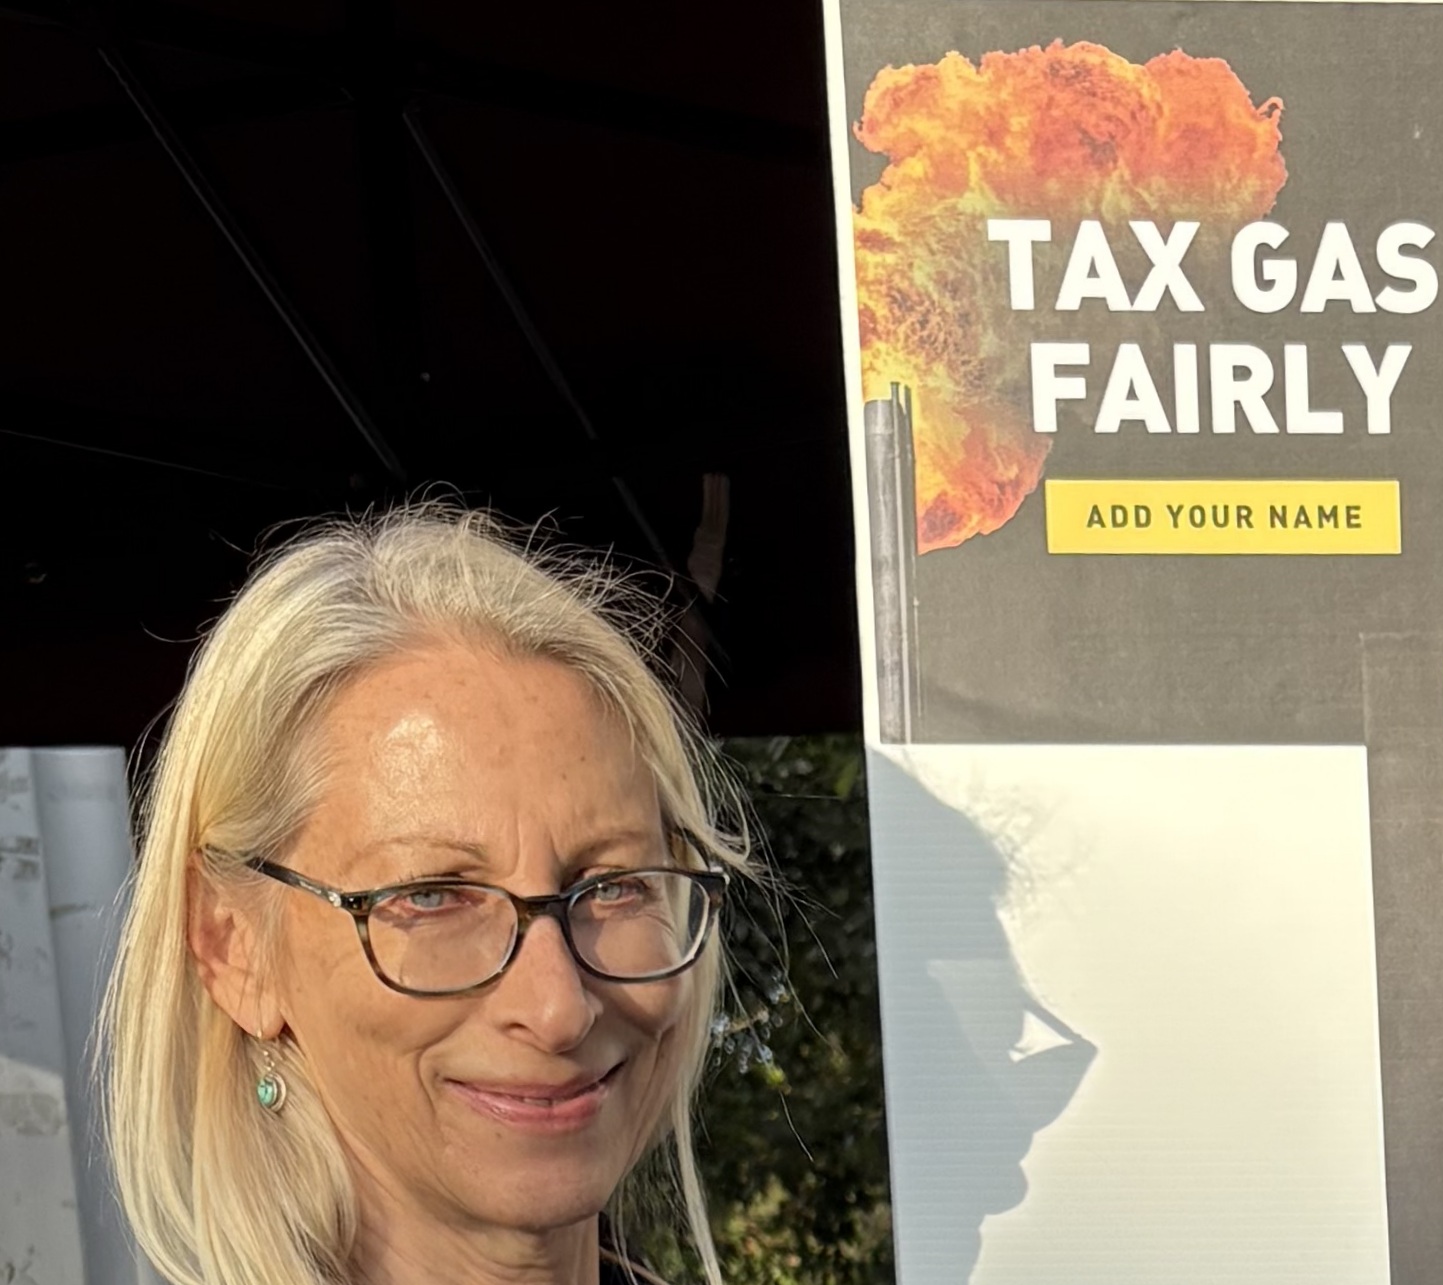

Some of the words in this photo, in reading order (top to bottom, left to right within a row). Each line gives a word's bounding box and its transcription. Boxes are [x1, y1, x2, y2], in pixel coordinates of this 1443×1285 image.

[986, 218, 1206, 312] TAX
[1230, 220, 1440, 315] GAS
[1029, 341, 1414, 435] FAIRLY
[1086, 503, 1152, 529] ADD
[1166, 503, 1255, 530] YOUR
[1268, 504, 1363, 530] NAME
